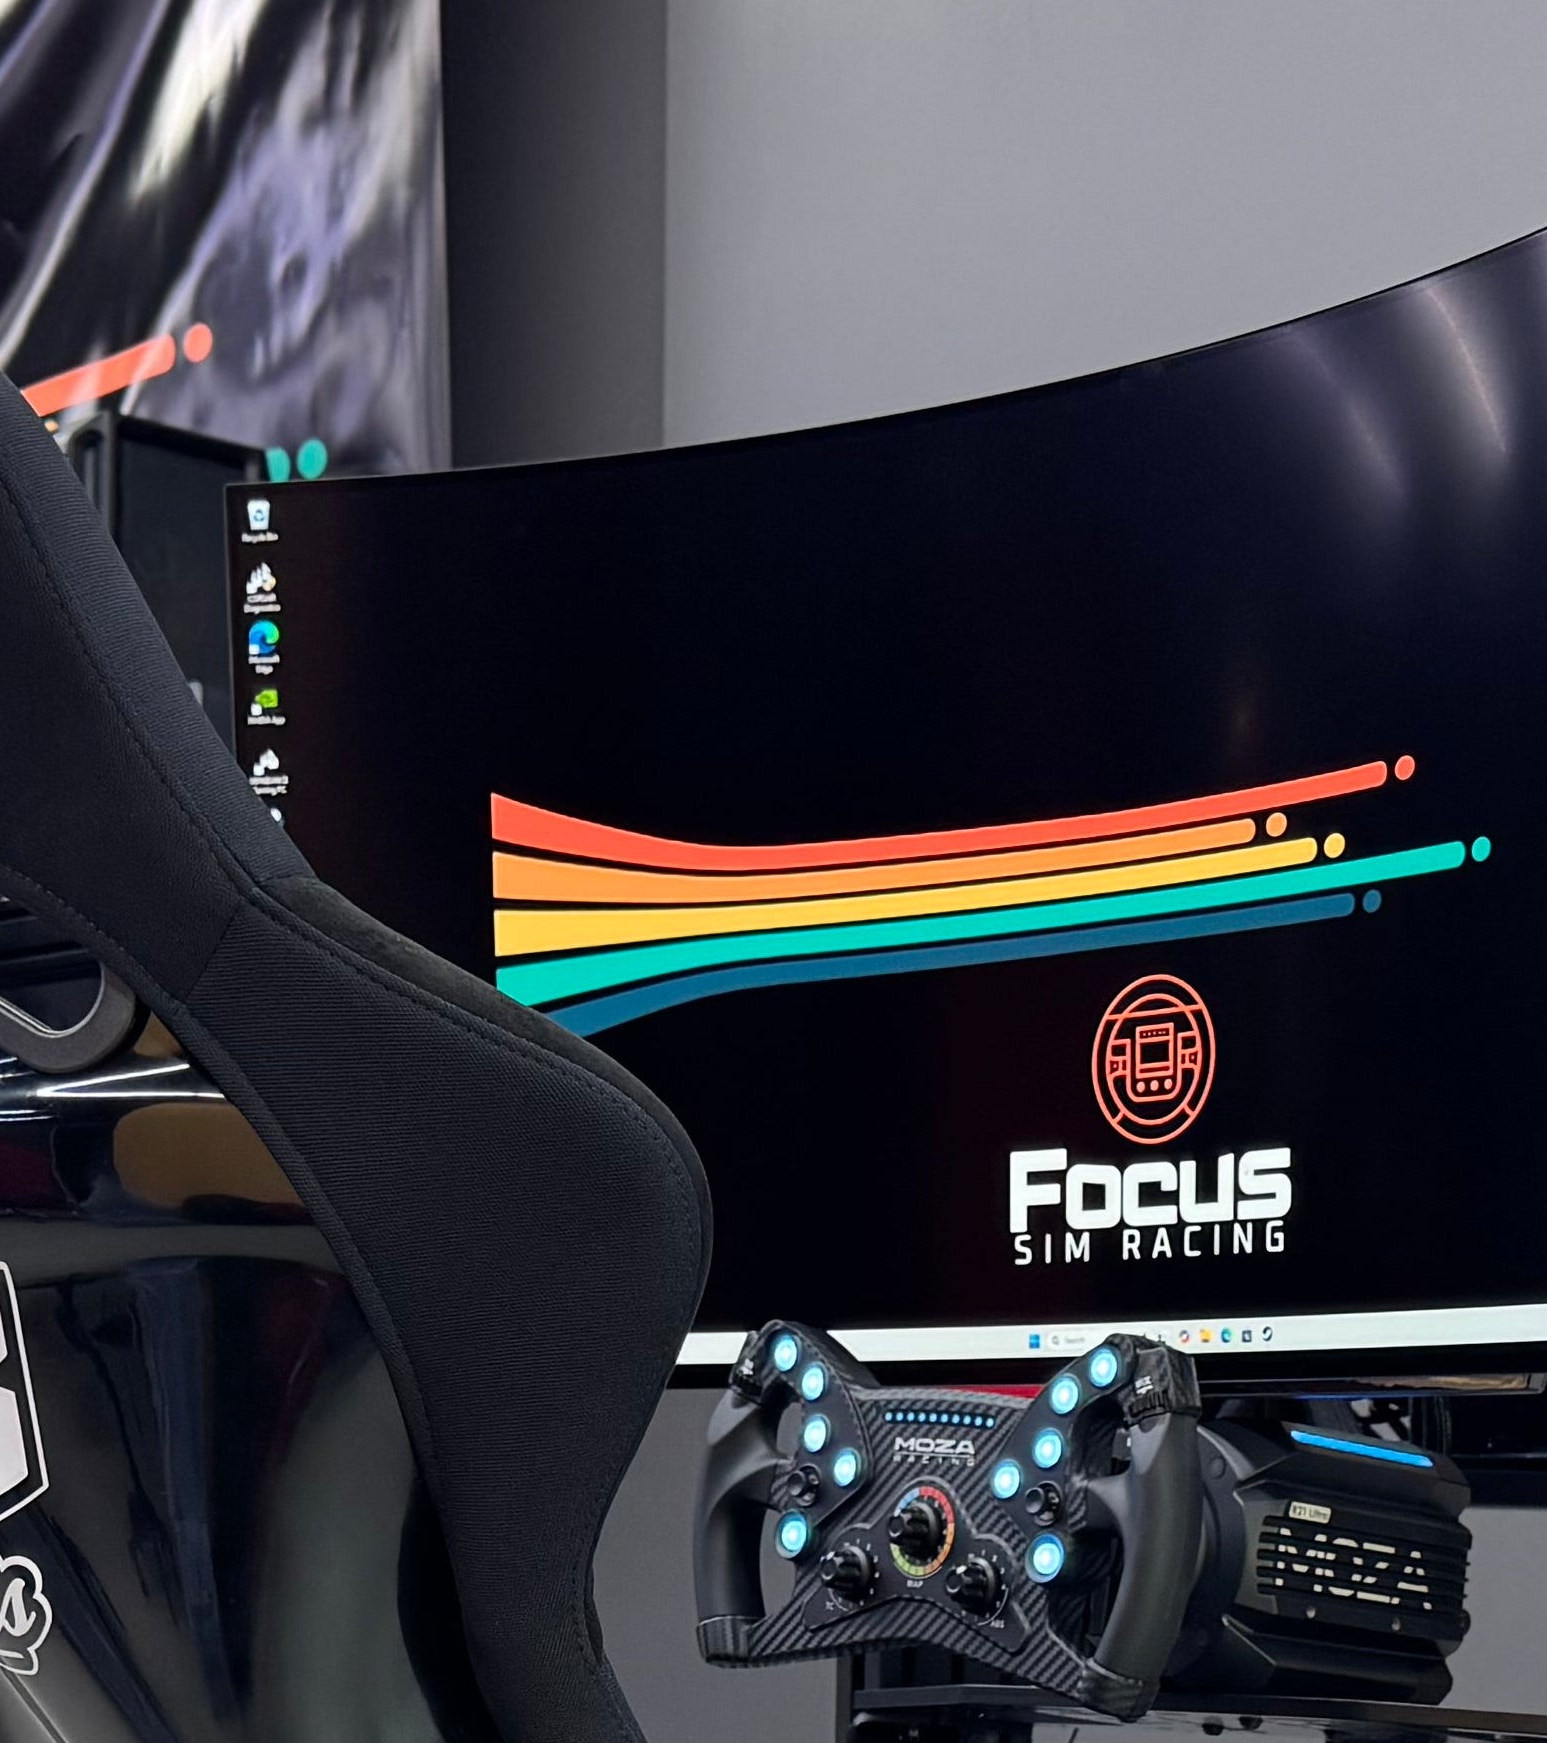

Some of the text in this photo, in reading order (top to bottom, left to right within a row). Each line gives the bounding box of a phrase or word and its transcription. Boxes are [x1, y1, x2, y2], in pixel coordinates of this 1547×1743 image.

[1009, 1147, 1292, 1234] FOCUS
[1014, 1220, 1285, 1266] SIM RACING
[893, 1436, 976, 1455] MOZA
